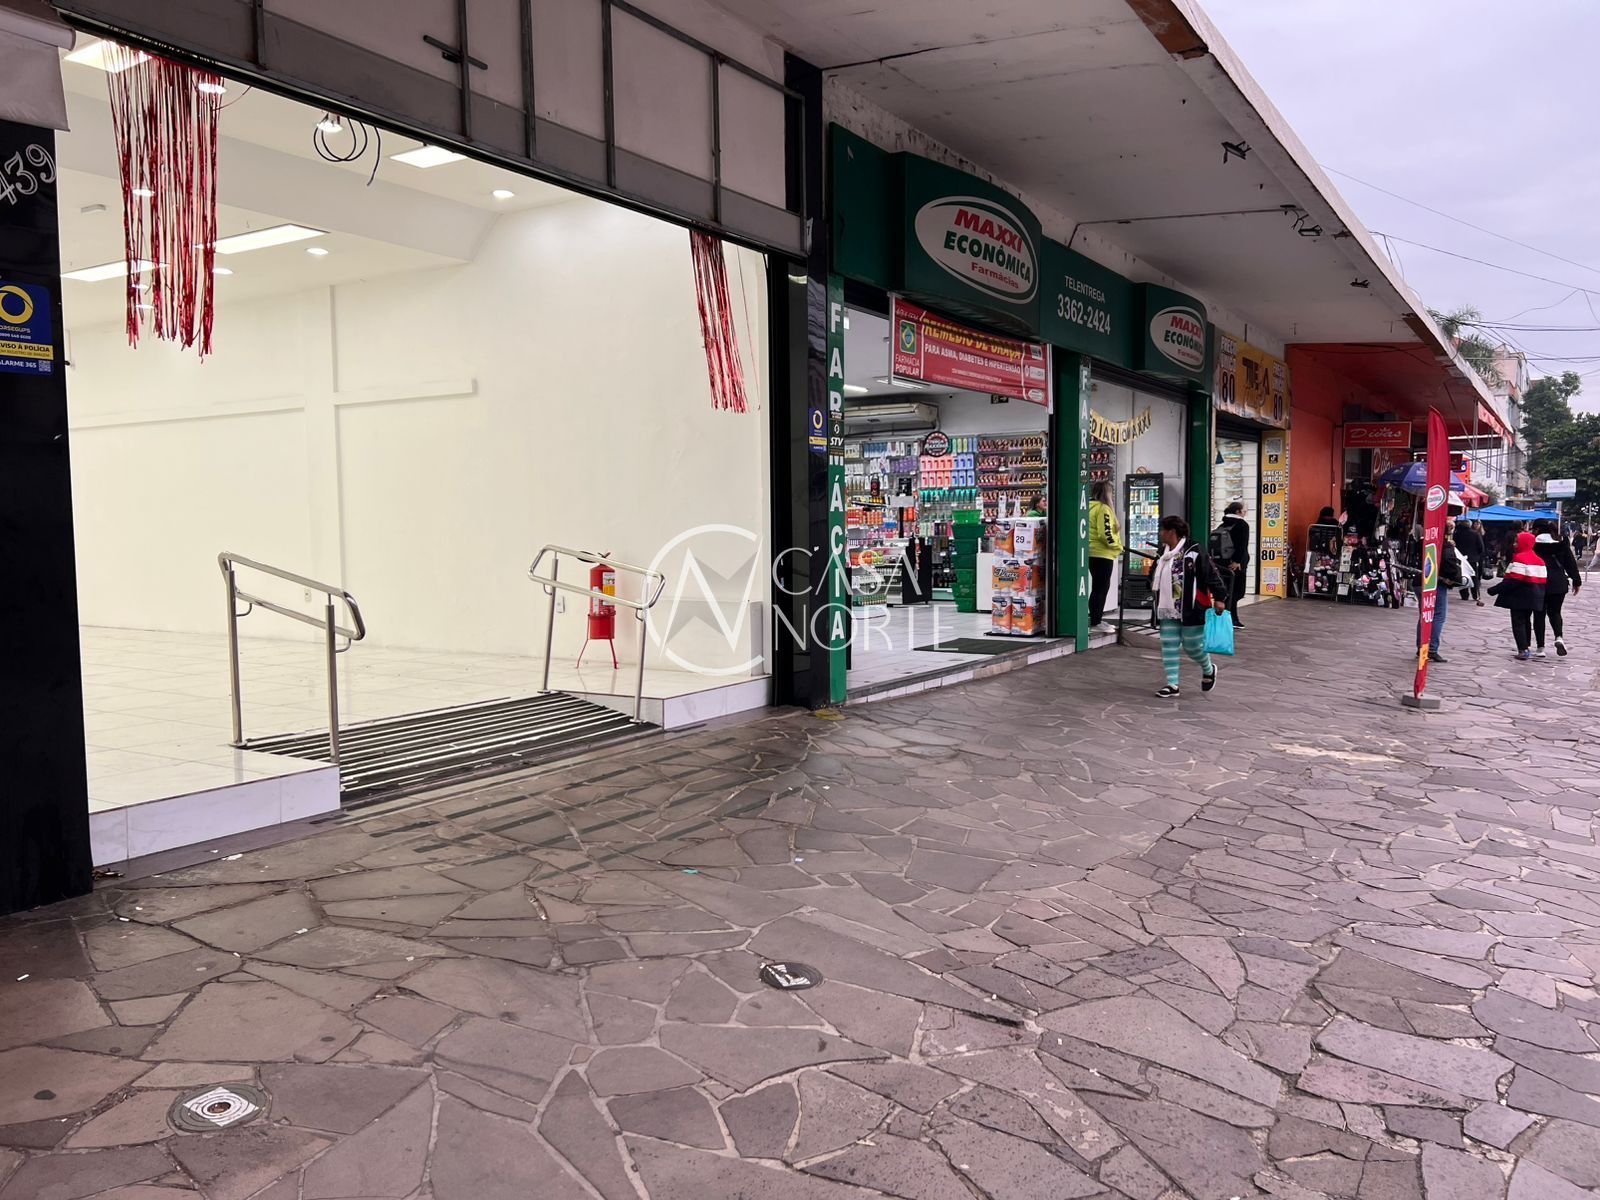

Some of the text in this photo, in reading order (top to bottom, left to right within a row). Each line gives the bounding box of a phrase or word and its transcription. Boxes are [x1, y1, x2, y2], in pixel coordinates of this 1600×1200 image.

[954, 209, 1023, 253] MAXXI
[944, 230, 1030, 283] ECONÔMICA
[971, 262, 1019, 288] Farmácias
[1065, 275, 1105, 303] TELENTREGA
[1057, 293, 1111, 335] 3362-2424
[925, 344, 940, 354] PARA
[959, 352, 984, 365] DIABETES
[895, 363, 919, 376] POPULAR
[1222, 371, 1236, 404] 80
[830, 437, 843, 446] STV
[1350, 428, 1402, 438] Divas
[1262, 483, 1276, 494] 80
[1261, 550, 1275, 560] 80
